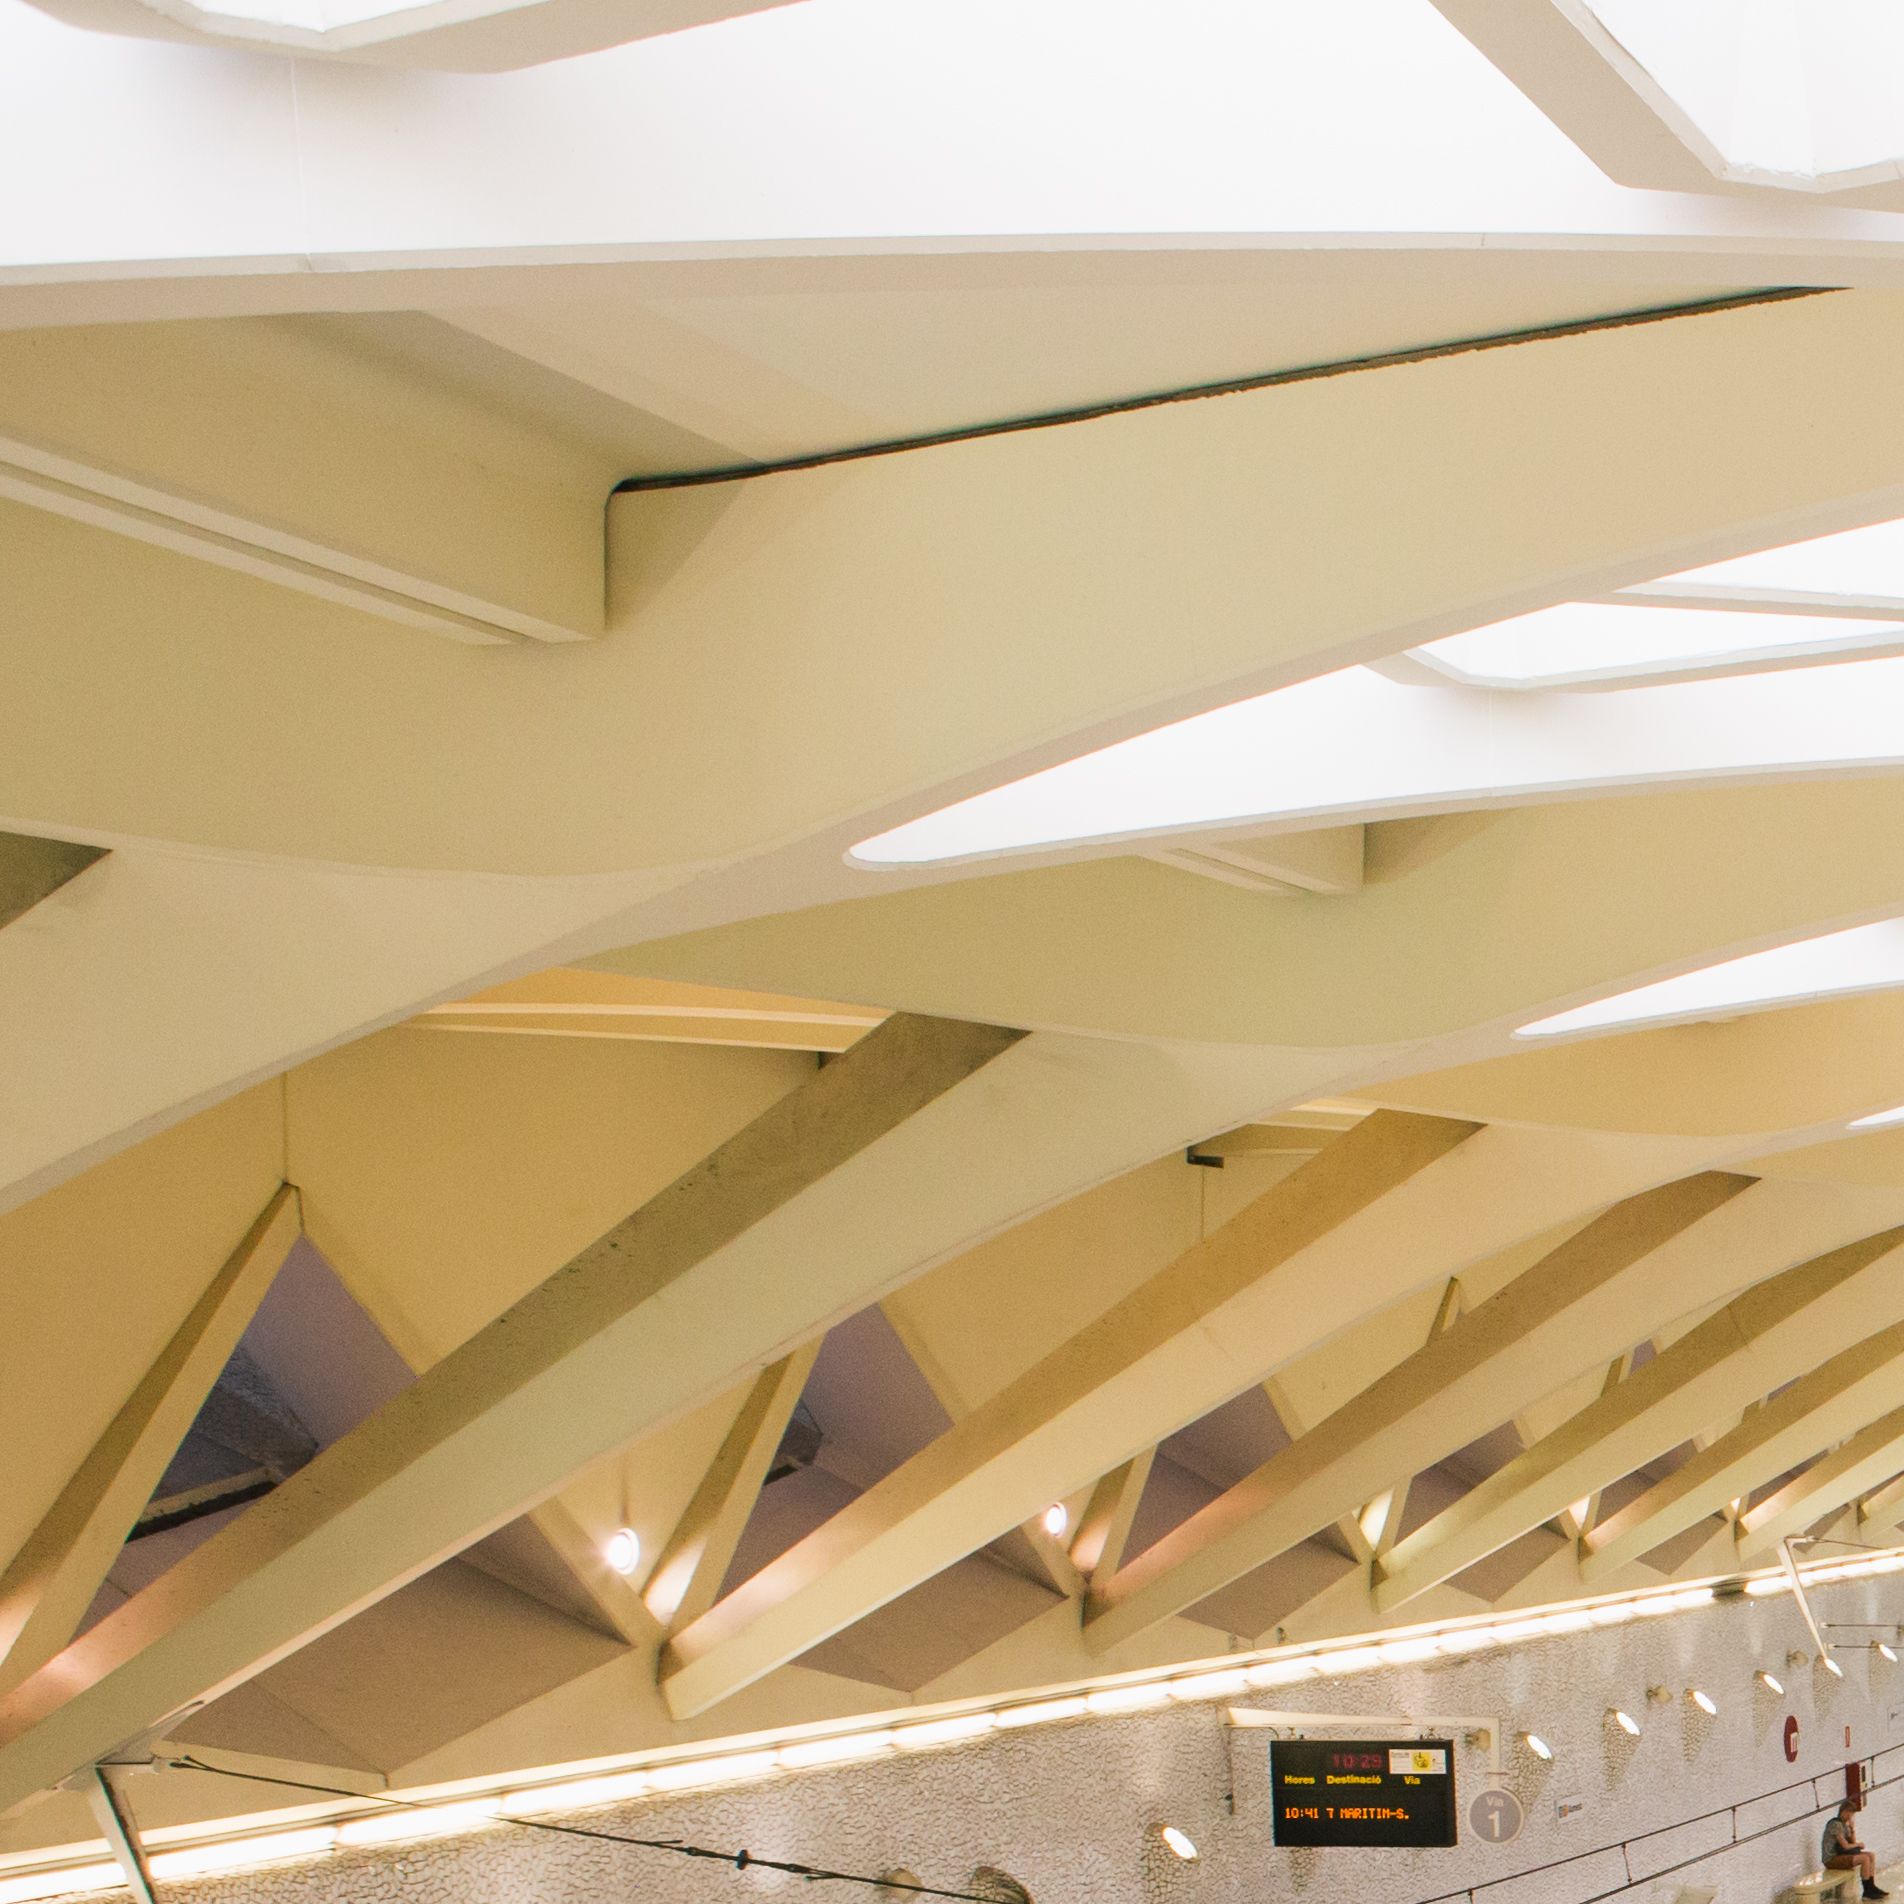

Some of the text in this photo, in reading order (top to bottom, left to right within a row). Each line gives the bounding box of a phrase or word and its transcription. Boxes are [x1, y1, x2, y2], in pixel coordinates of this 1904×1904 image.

[1284, 1774, 1421, 1785] Hores Destinació Via
[1486, 1797, 1504, 1807] Via
[1285, 1807, 1409, 1819] 10:41 7 MARITIM-S.
[1487, 1810, 1500, 1838] 1
